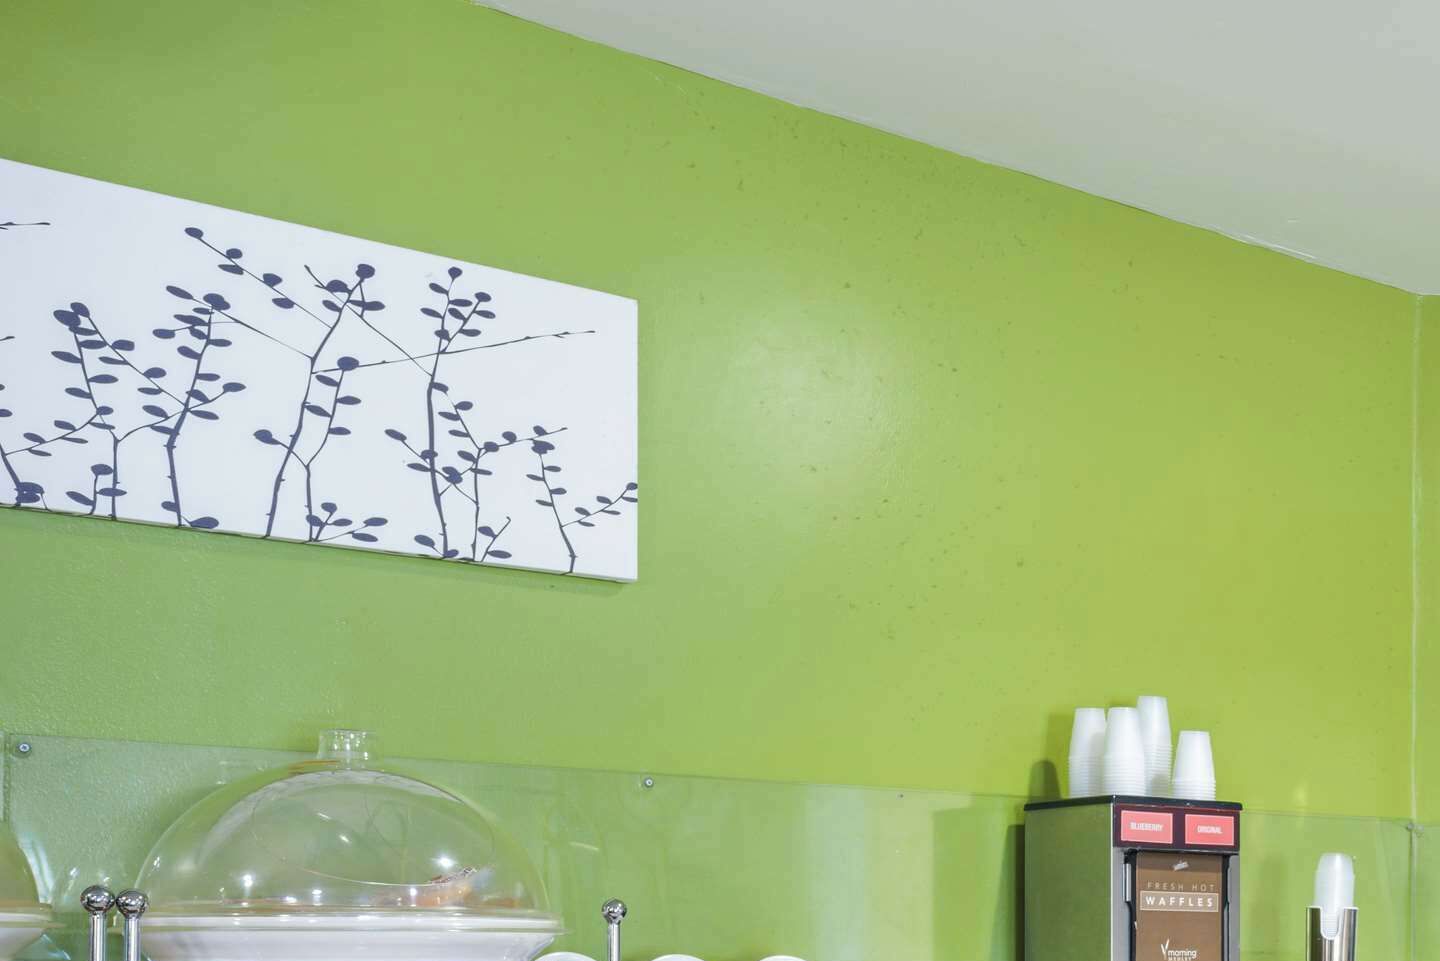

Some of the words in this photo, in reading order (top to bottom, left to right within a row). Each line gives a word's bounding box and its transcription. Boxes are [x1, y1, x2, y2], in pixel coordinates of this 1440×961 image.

[1130, 821, 1163, 833] BLUEBERRY
[1147, 881, 1184, 891] FRESH
[1191, 883, 1215, 892] HOT
[1145, 895, 1213, 907] WAFFLES
[1168, 948, 1197, 960] morning
